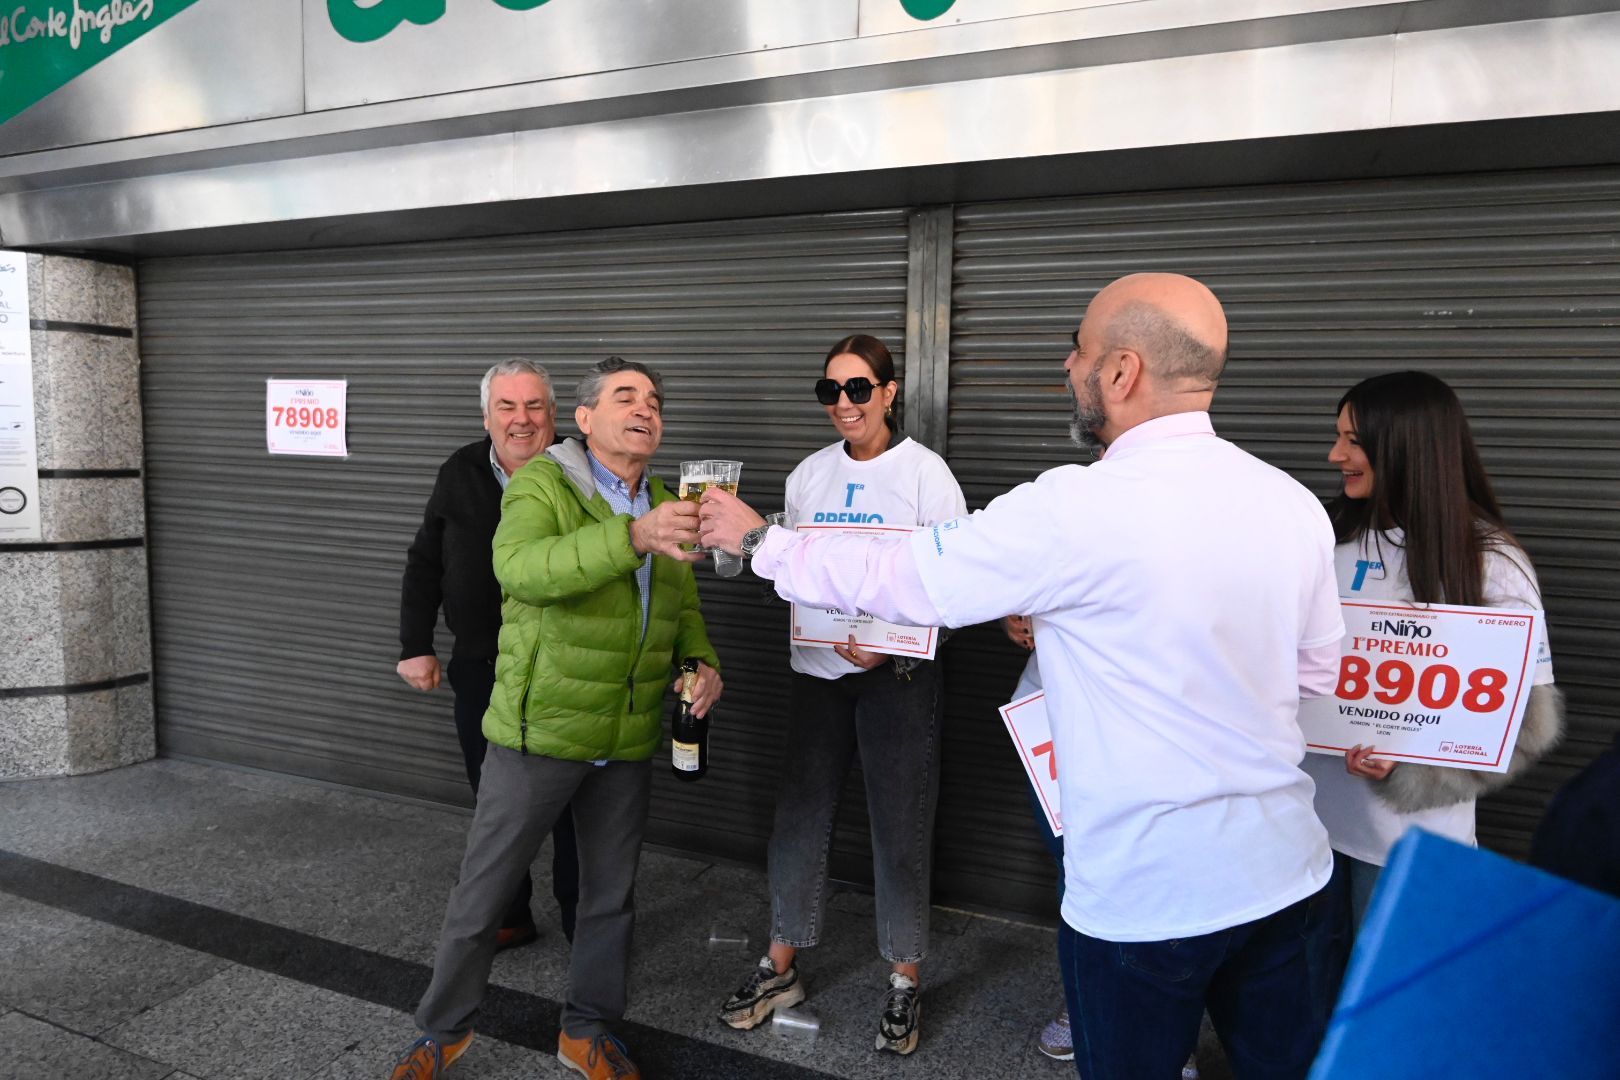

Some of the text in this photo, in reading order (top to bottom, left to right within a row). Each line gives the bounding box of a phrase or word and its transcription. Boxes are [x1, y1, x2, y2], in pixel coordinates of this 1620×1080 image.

[0, 16, 10, 47] l
[11, 6, 67, 43] Corte
[272, 406, 339, 429] 78908
[1371, 618, 1432, 640] El Niño
[1497, 619, 1526, 627] ENERO
[1365, 637, 1449, 659] PREMIO
[1335, 655, 1508, 714] 8908
[1338, 705, 1401, 721] VENDIDO
[1453, 749, 1488, 757] NACIONAL
